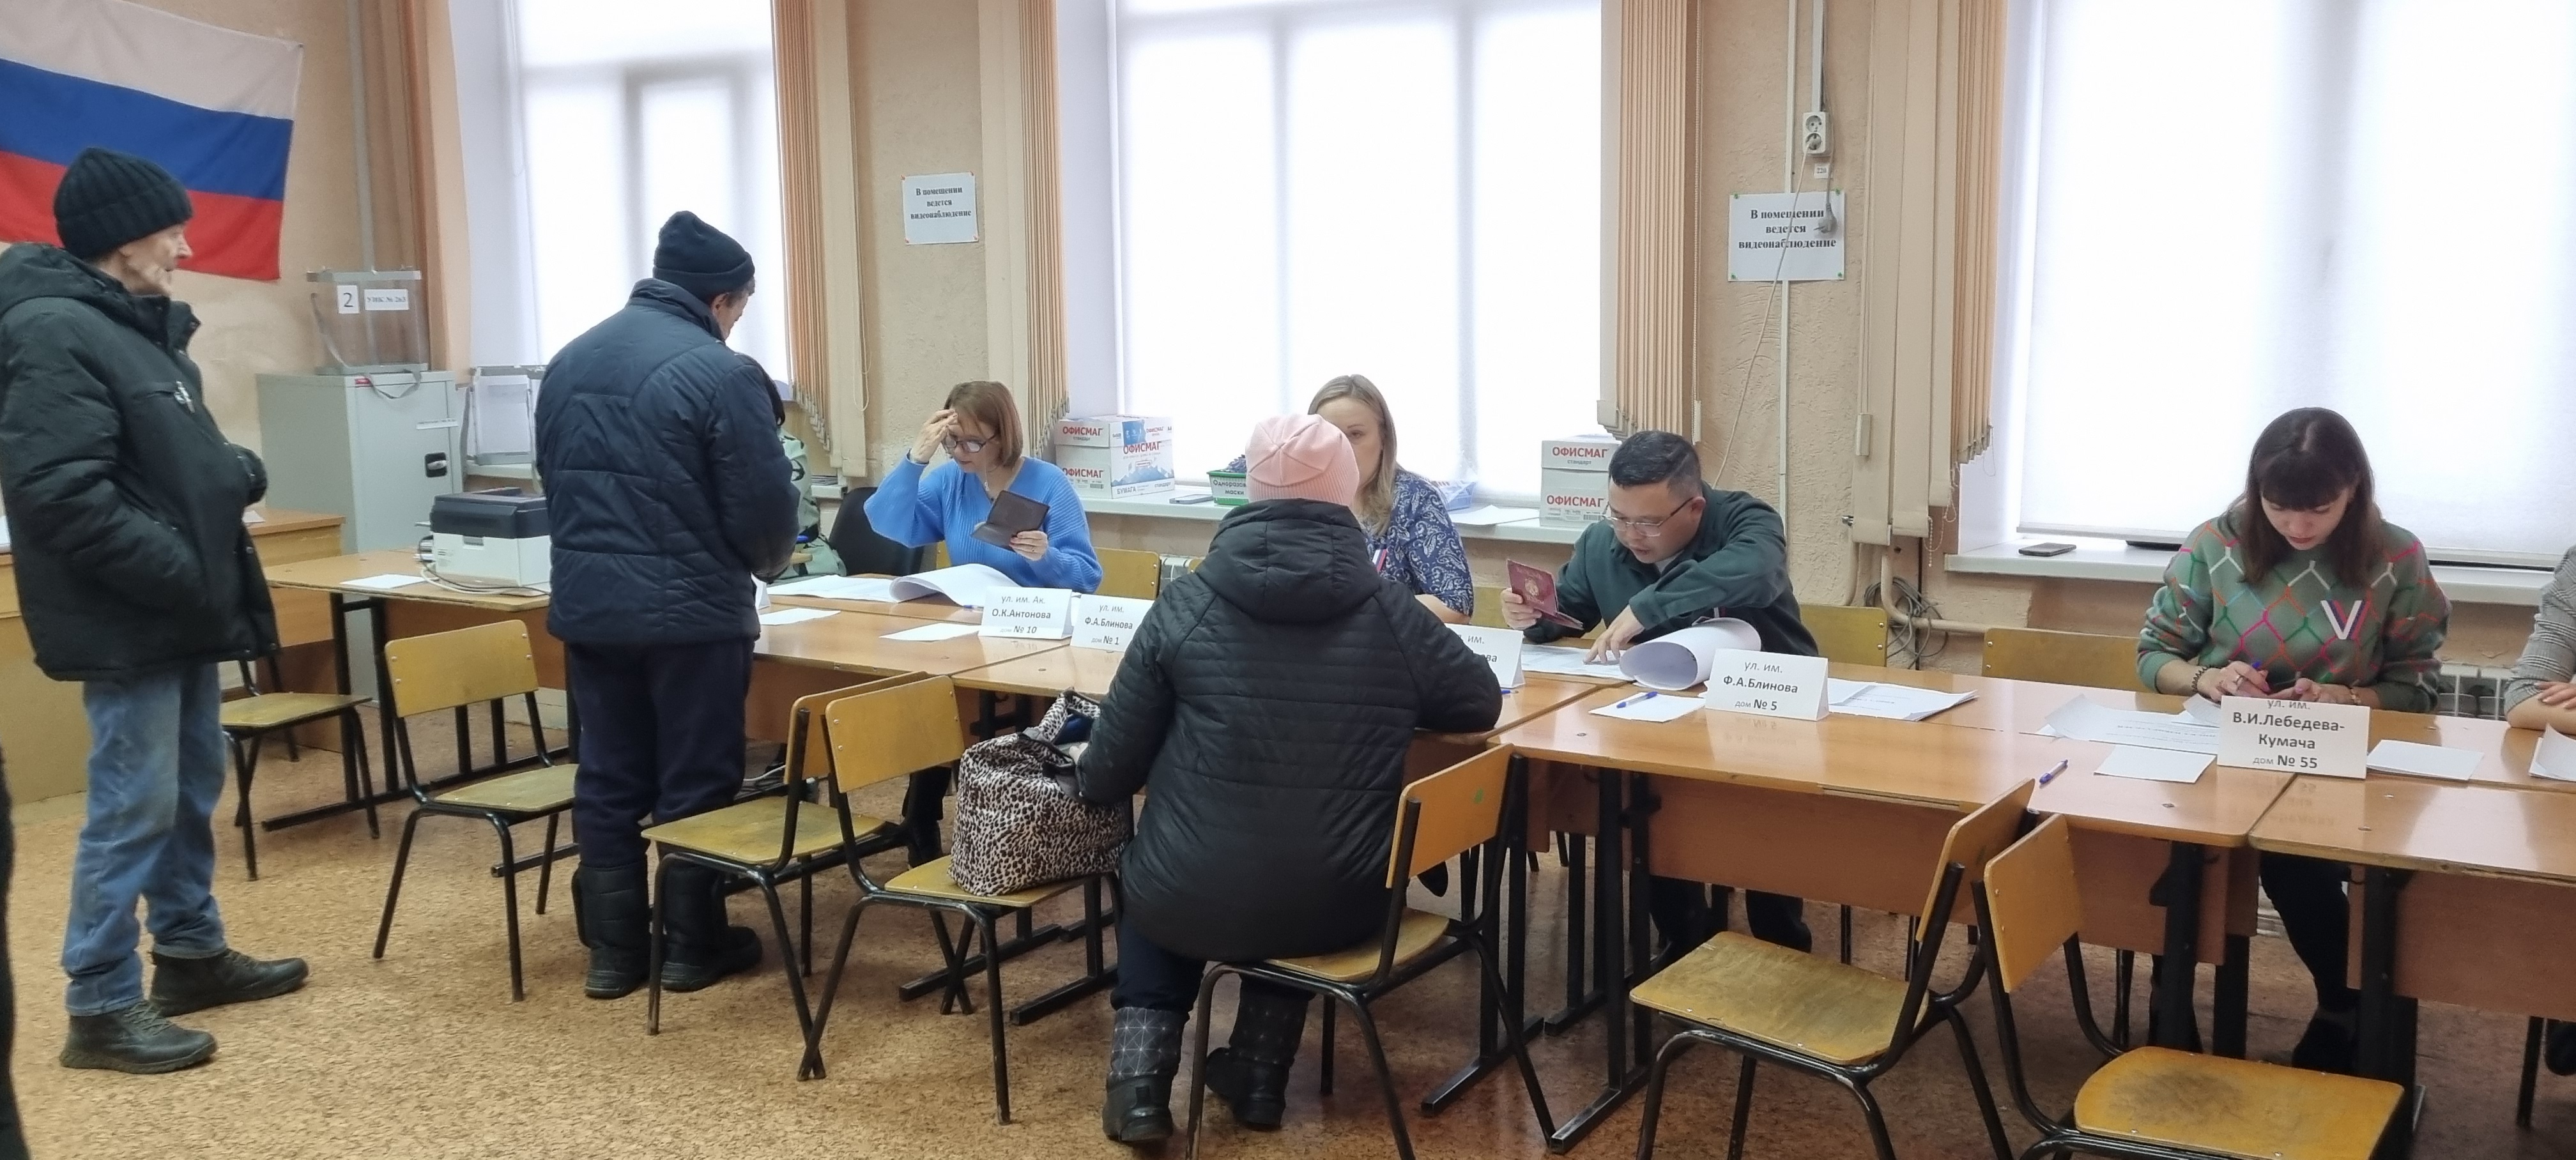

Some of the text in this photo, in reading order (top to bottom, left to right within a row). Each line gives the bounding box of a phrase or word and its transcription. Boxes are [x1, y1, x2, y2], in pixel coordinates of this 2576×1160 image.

[923, 187, 963, 195] помещении
[910, 210, 972, 220] видеонаблюдение
[1751, 210, 1824, 220] В помещении
[1765, 225, 1806, 234] ведется
[1738, 238, 1836, 249] видеонаблюдение
[343, 292, 353, 307] 2
[1062, 426, 1103, 436] ОФИСМАГ
[1123, 441, 1162, 454] ОФИСМАГ
[1552, 446, 1608, 458] ОФИСМАГ
[1062, 468, 1103, 478] ОФИСМАГ
[1213, 479, 1246, 487] Одноразов
[1117, 486, 1137, 494] БУМАГА
[1547, 494, 1604, 507] ОФИСМАГ
[1001, 595, 1013, 604] ул.
[1032, 596, 1046, 604] Ак.
[992, 608, 1051, 619] О.К.Антонова
[1099, 604, 1110, 613] ул.
[1084, 617, 1133, 629] Ф.А.Блинова
[1013, 625, 1025, 634] №
[1026, 626, 1037, 634] 10
[1103, 636, 1113, 645] №
[1468, 636, 1485, 645] им.
[1744, 662, 1783, 673] ул. им.
[1723, 675, 1798, 693] Ф.А.Блинова
[1753, 699, 1768, 710] №
[1770, 701, 1777, 711] 5
[2267, 699, 2311, 710] ул. им.
[2232, 712, 2345, 731] В.И.Лебедева-
[2258, 734, 2316, 749] Кумача
[2252, 755, 2318, 768] дом № 55
